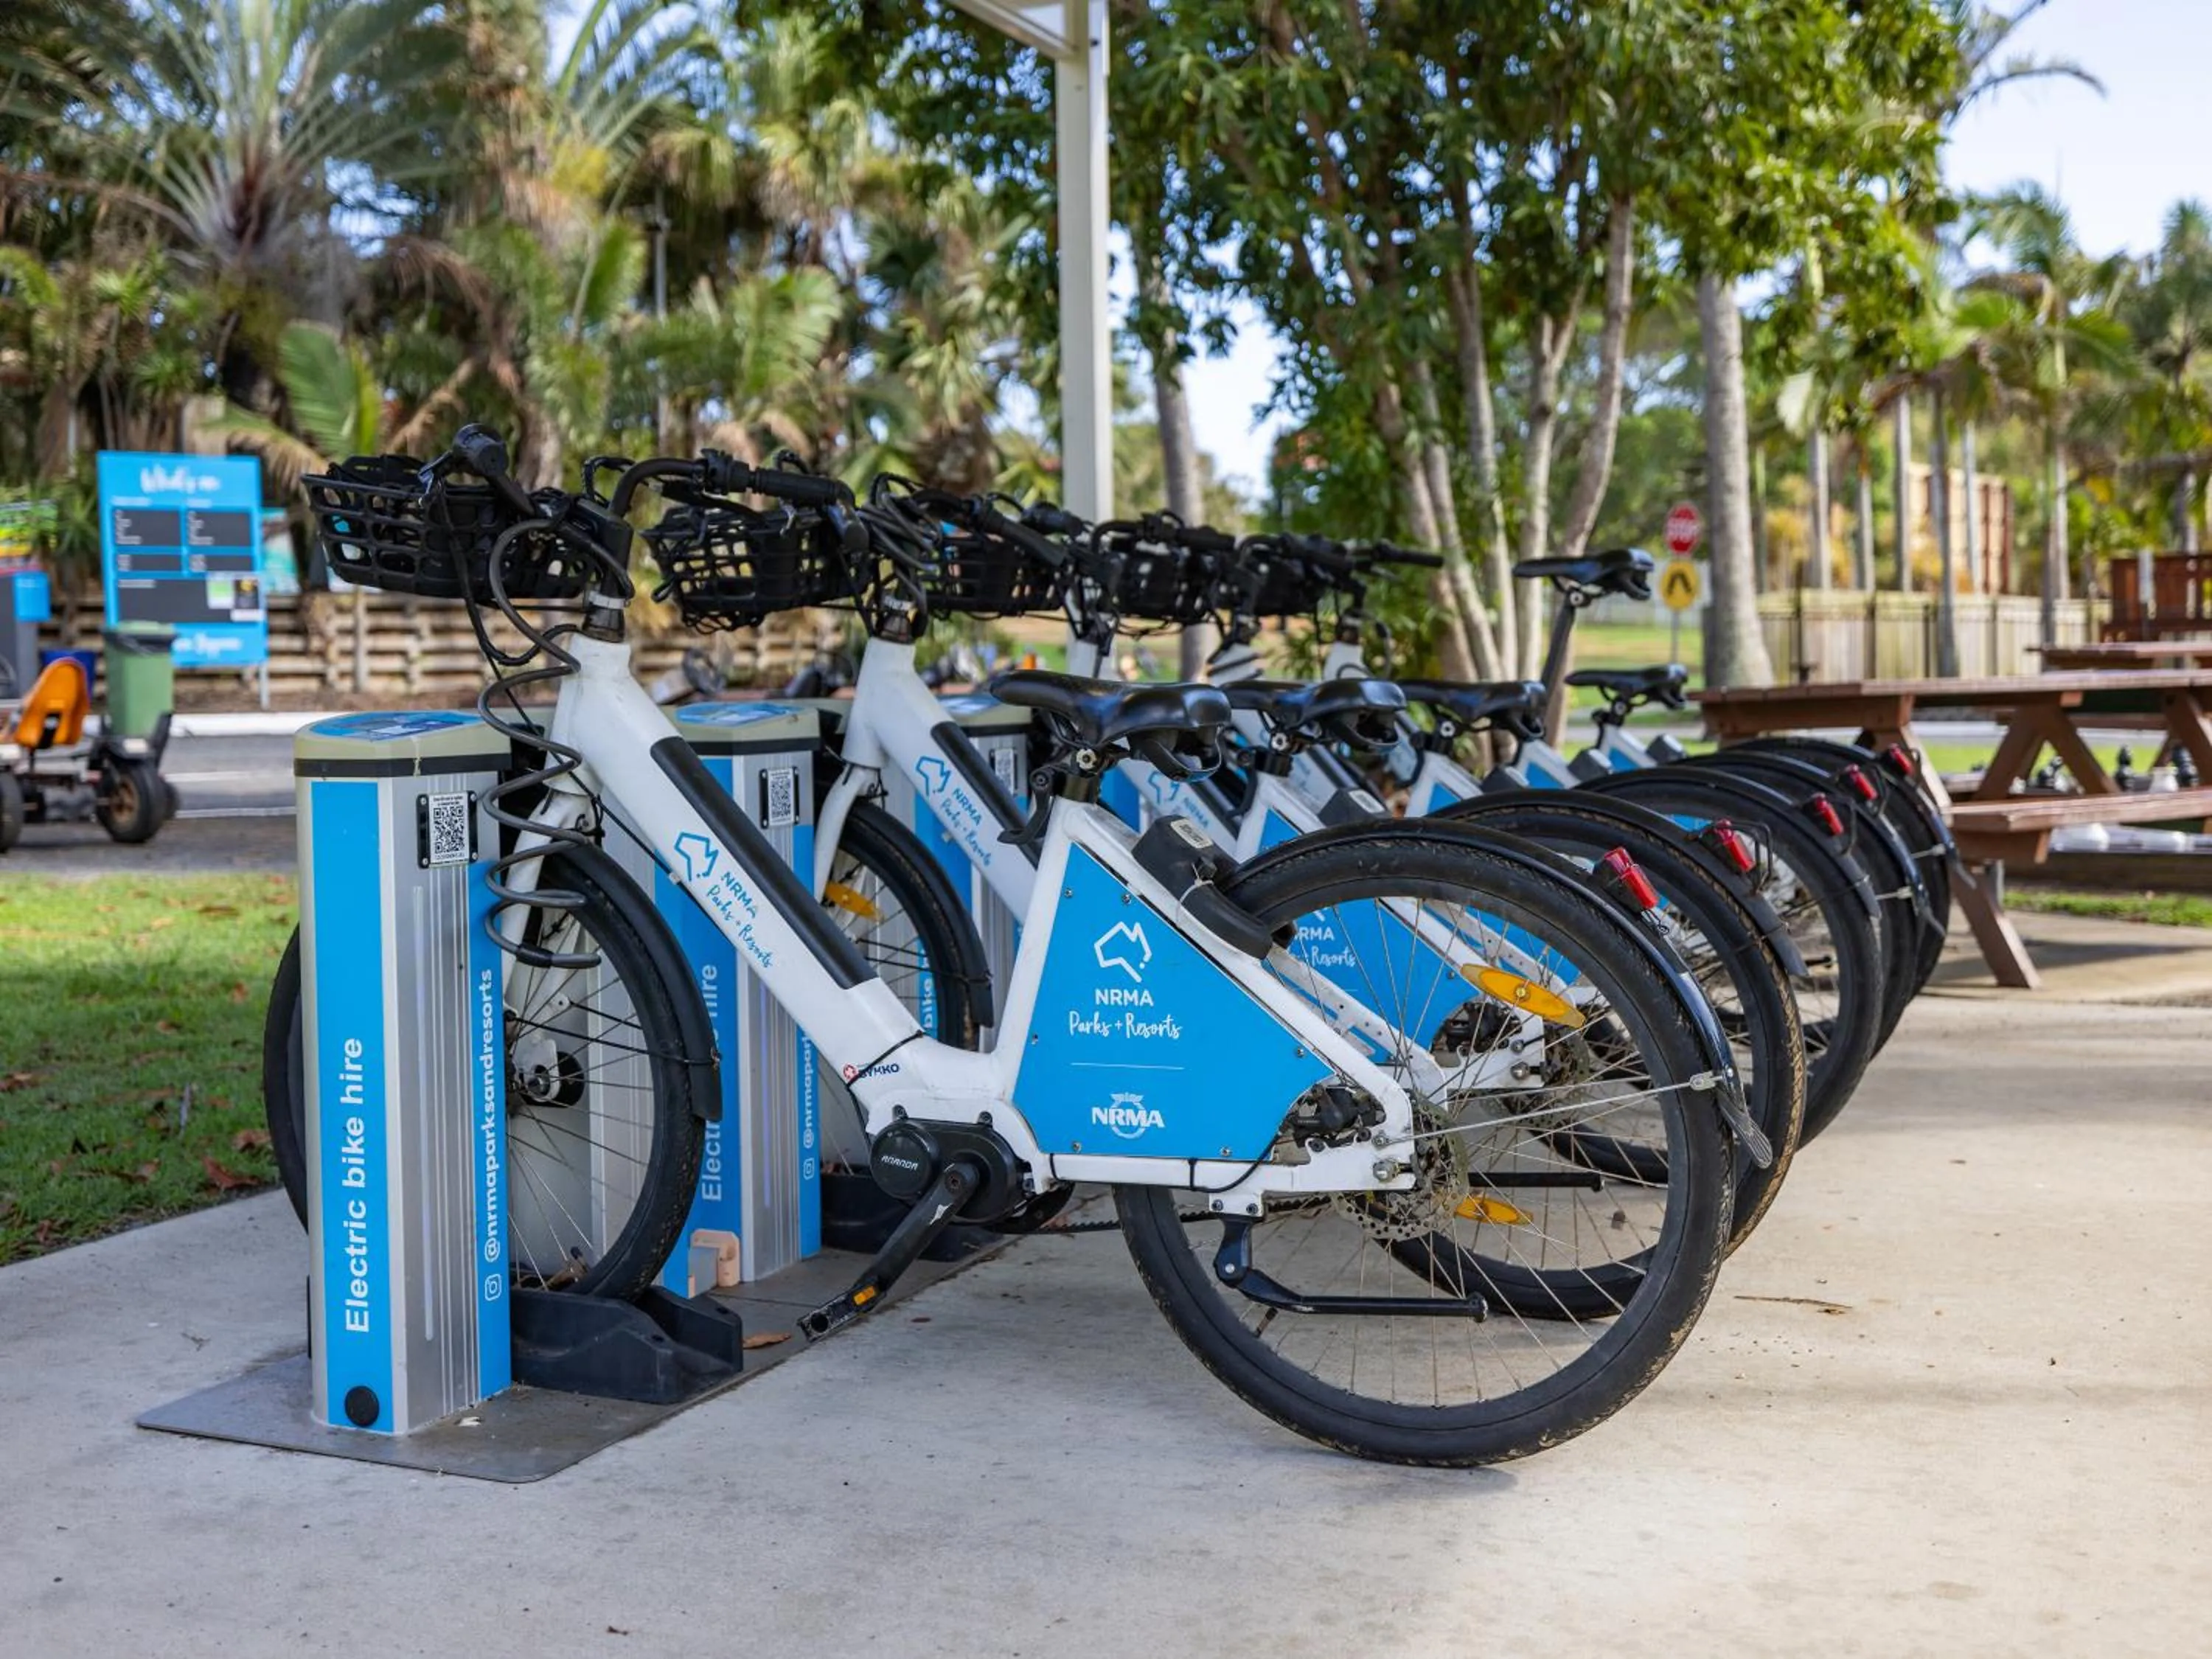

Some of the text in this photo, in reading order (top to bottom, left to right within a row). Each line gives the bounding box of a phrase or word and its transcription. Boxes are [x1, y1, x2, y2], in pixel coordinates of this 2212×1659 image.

[952, 787, 982, 826] NRMA
[720, 870, 758, 919] NRMA
[706, 884, 734, 922] Parks
[737, 923, 773, 969] Resorts
[1294, 926, 1335, 942] RMA
[1094, 988, 1154, 1007] NRMA
[1068, 1010, 1112, 1037] Parks
[1124, 1012, 1183, 1040] Resorts
[479, 968, 501, 1263] @nrmaparksandresorts
[1091, 1106, 1166, 1128] NRMA
[339, 1037, 370, 1333] Electric bike hire
